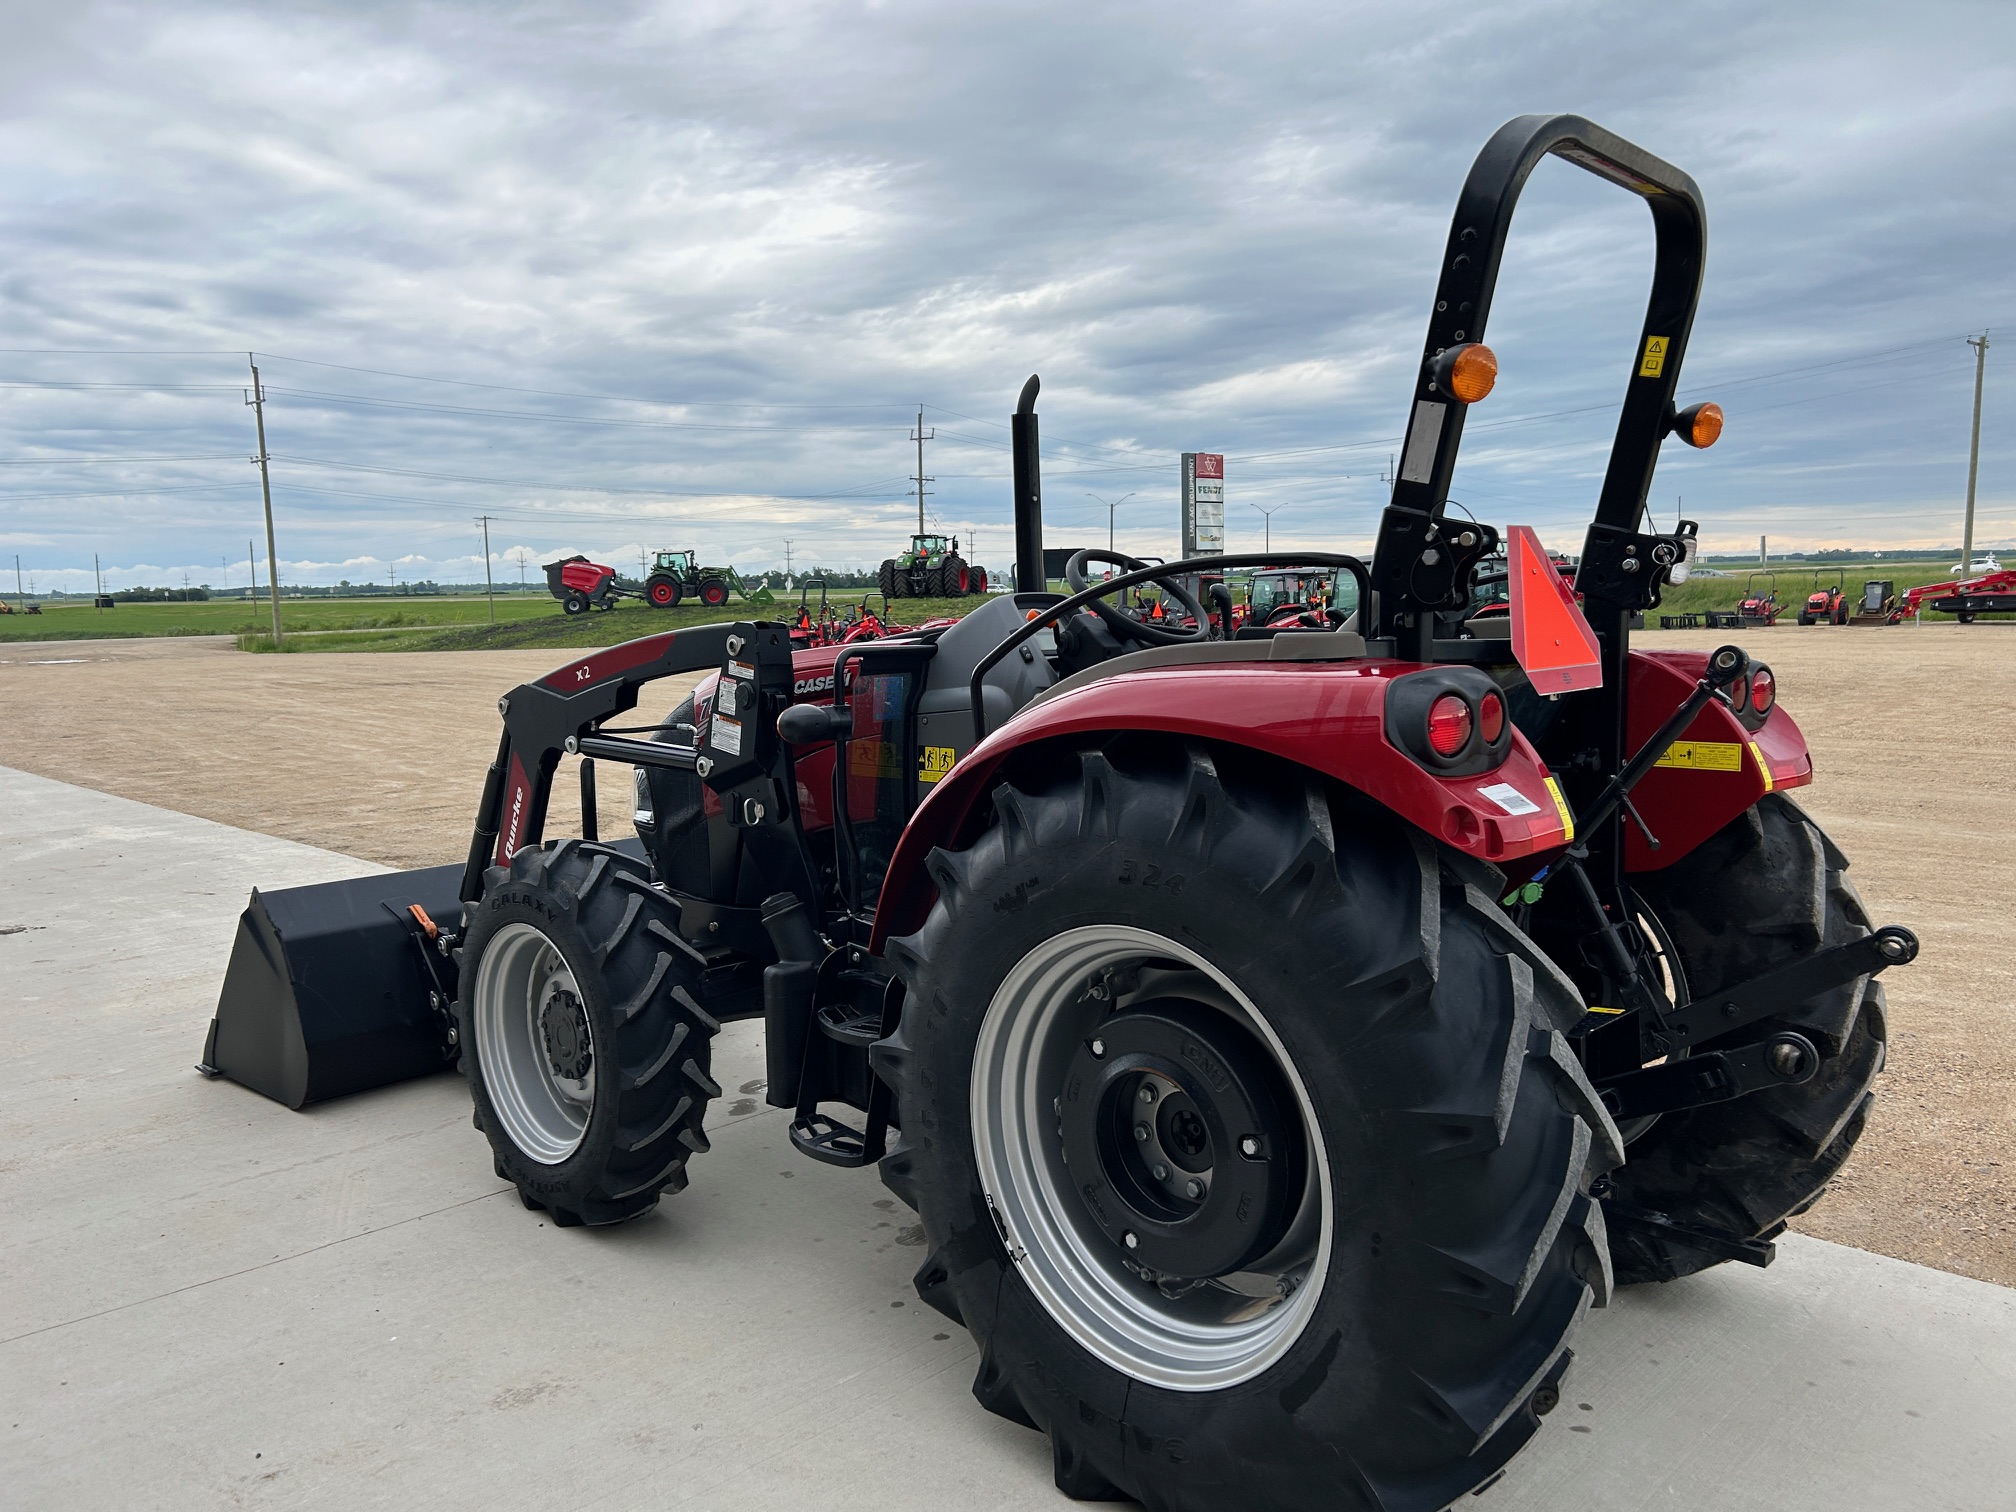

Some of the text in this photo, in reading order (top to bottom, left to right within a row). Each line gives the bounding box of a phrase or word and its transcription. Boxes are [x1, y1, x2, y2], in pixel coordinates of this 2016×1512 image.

[1197, 485, 1222, 495] FENDT
[793, 675, 835, 695] CASE
[504, 786, 523, 860] Quicke
[1118, 857, 1186, 897] 324
[491, 891, 560, 924] GALAXY
